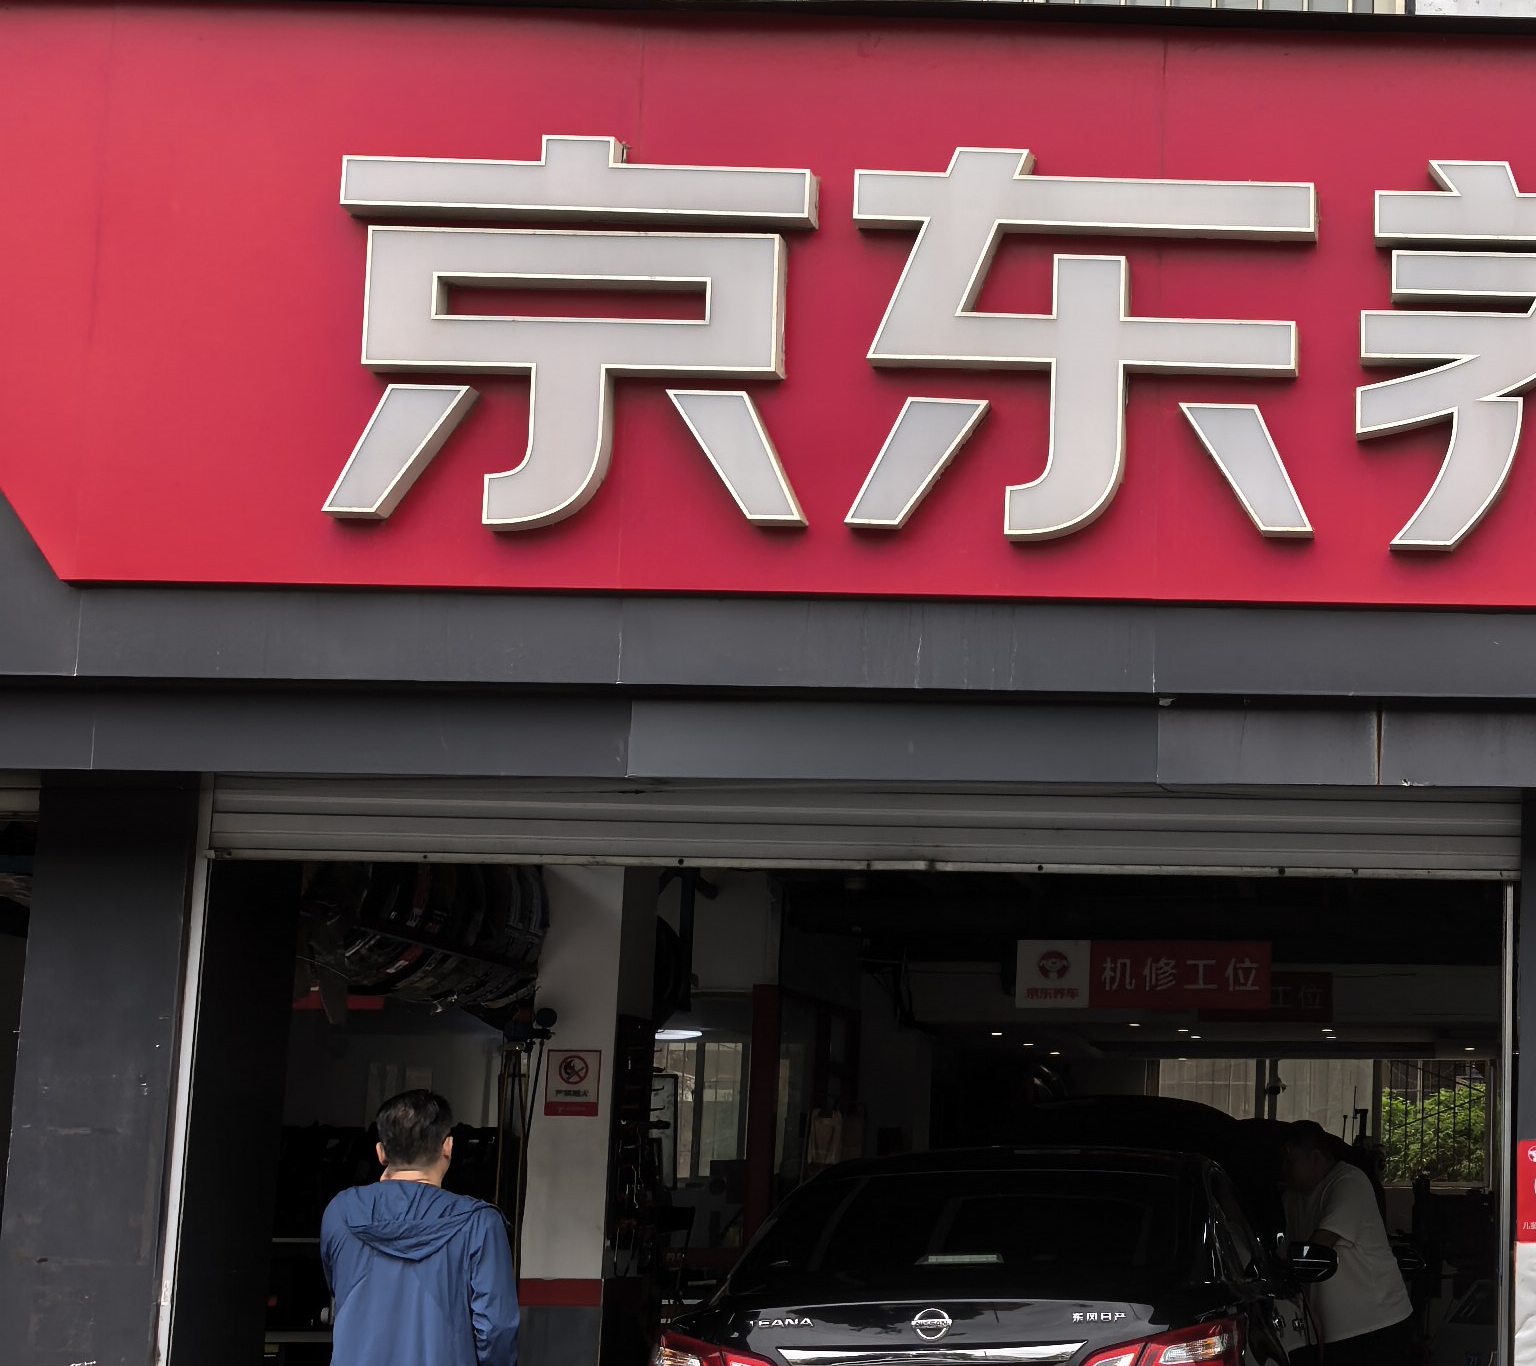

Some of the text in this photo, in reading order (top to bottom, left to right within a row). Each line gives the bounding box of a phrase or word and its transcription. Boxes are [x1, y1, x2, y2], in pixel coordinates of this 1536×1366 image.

[1101, 956, 1260, 992] 机修工位
[747, 1317, 814, 1328] TEANA
[1072, 1312, 1127, 1323] 东风日产
